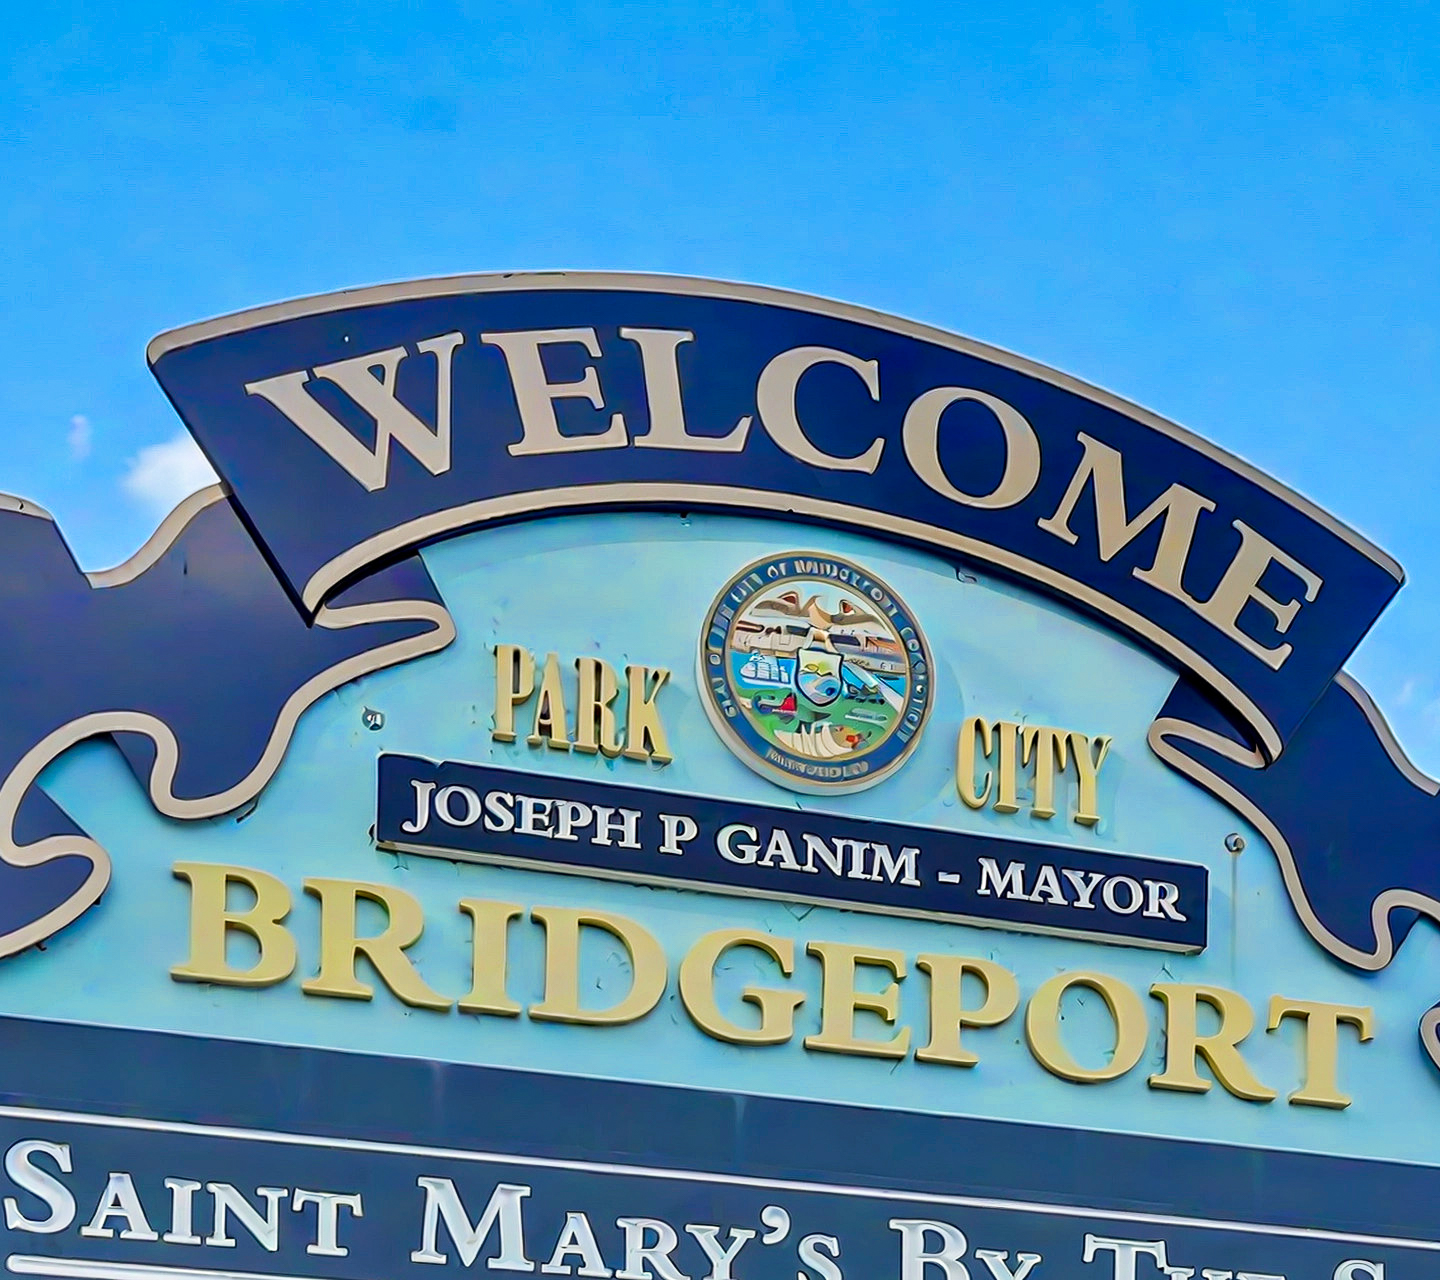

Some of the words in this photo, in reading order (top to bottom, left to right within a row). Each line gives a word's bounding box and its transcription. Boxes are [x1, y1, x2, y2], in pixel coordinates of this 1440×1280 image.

[243, 324, 1326, 671] WELCOME
[494, 644, 672, 764] PARK
[954, 718, 1113, 826] CITY
[403, 777, 642, 850] JOSEPH
[659, 813, 698, 856] P
[715, 821, 921, 886] GANIM
[976, 856, 1189, 922] MAYOR
[170, 860, 1375, 1112] BRIDGEPORT
[3, 1138, 364, 1258] SAINT
